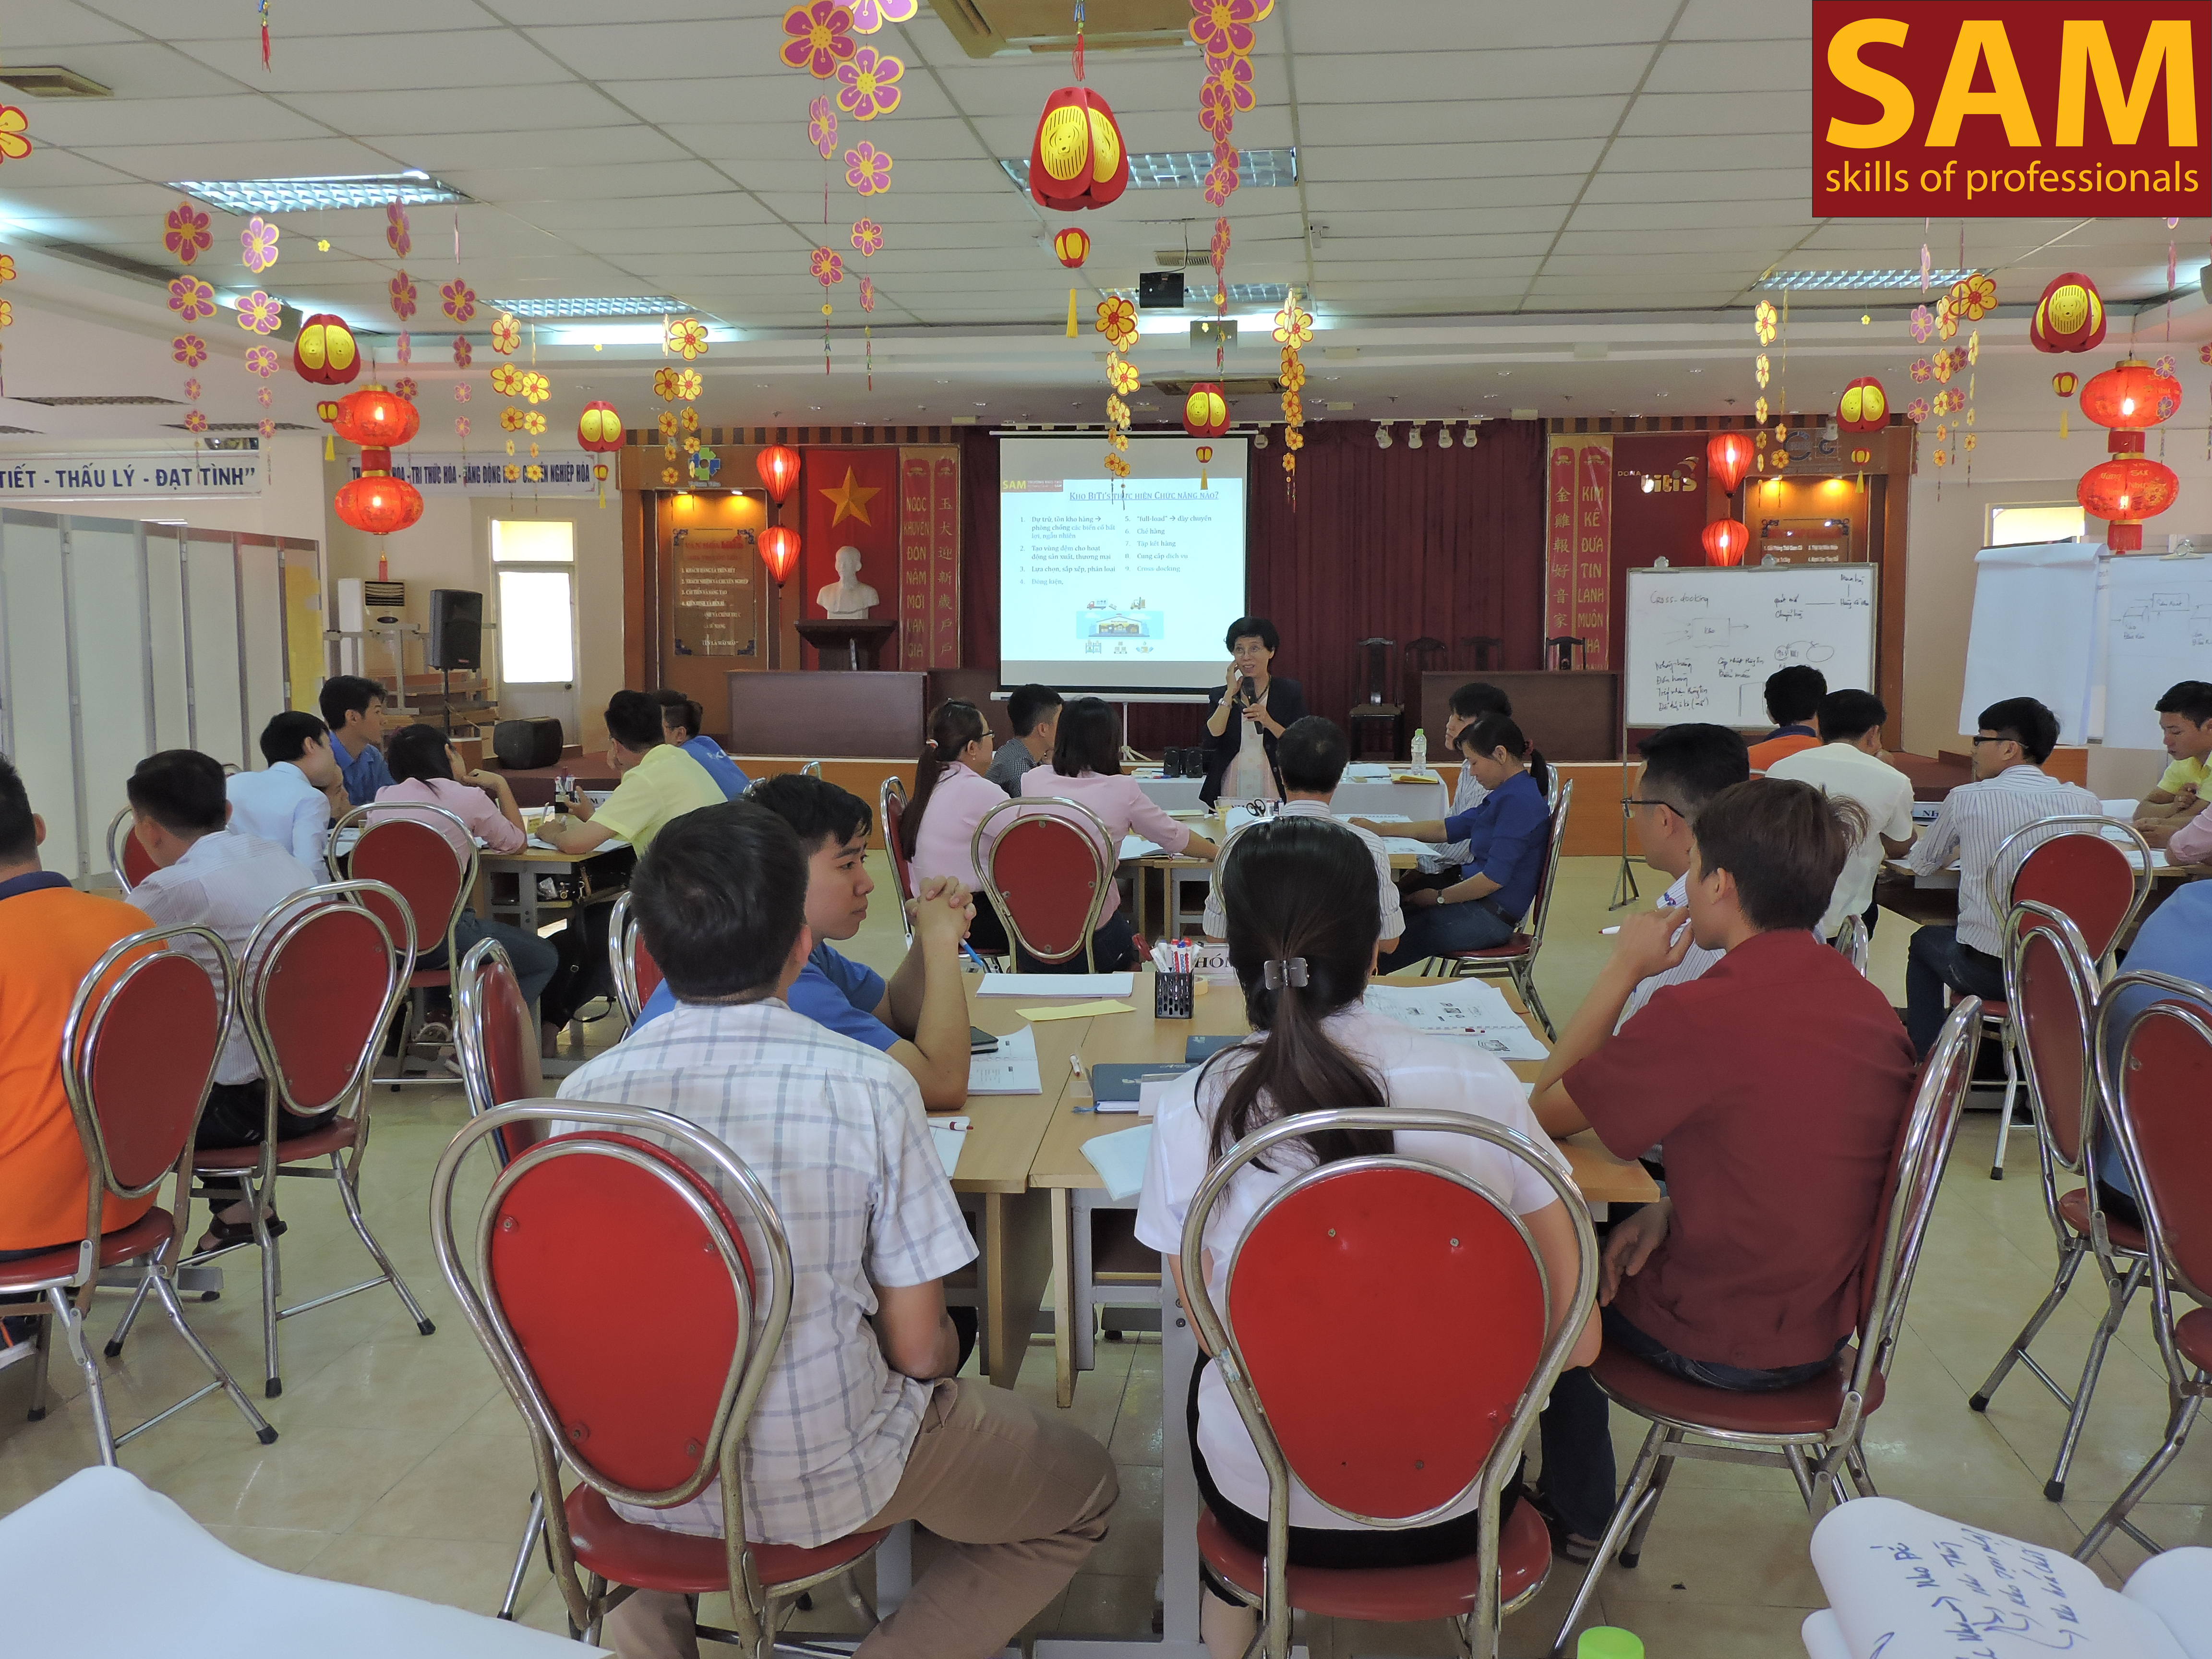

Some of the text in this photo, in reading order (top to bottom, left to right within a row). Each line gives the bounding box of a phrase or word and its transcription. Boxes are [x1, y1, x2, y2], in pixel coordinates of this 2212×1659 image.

[55, 462, 106, 488] THẤU
[112, 463, 135, 488] LÝ
[155, 468, 192, 491] ĐẠT
[1002, 480, 1026, 490] SAM
[1580, 563, 1602, 578] TIN
